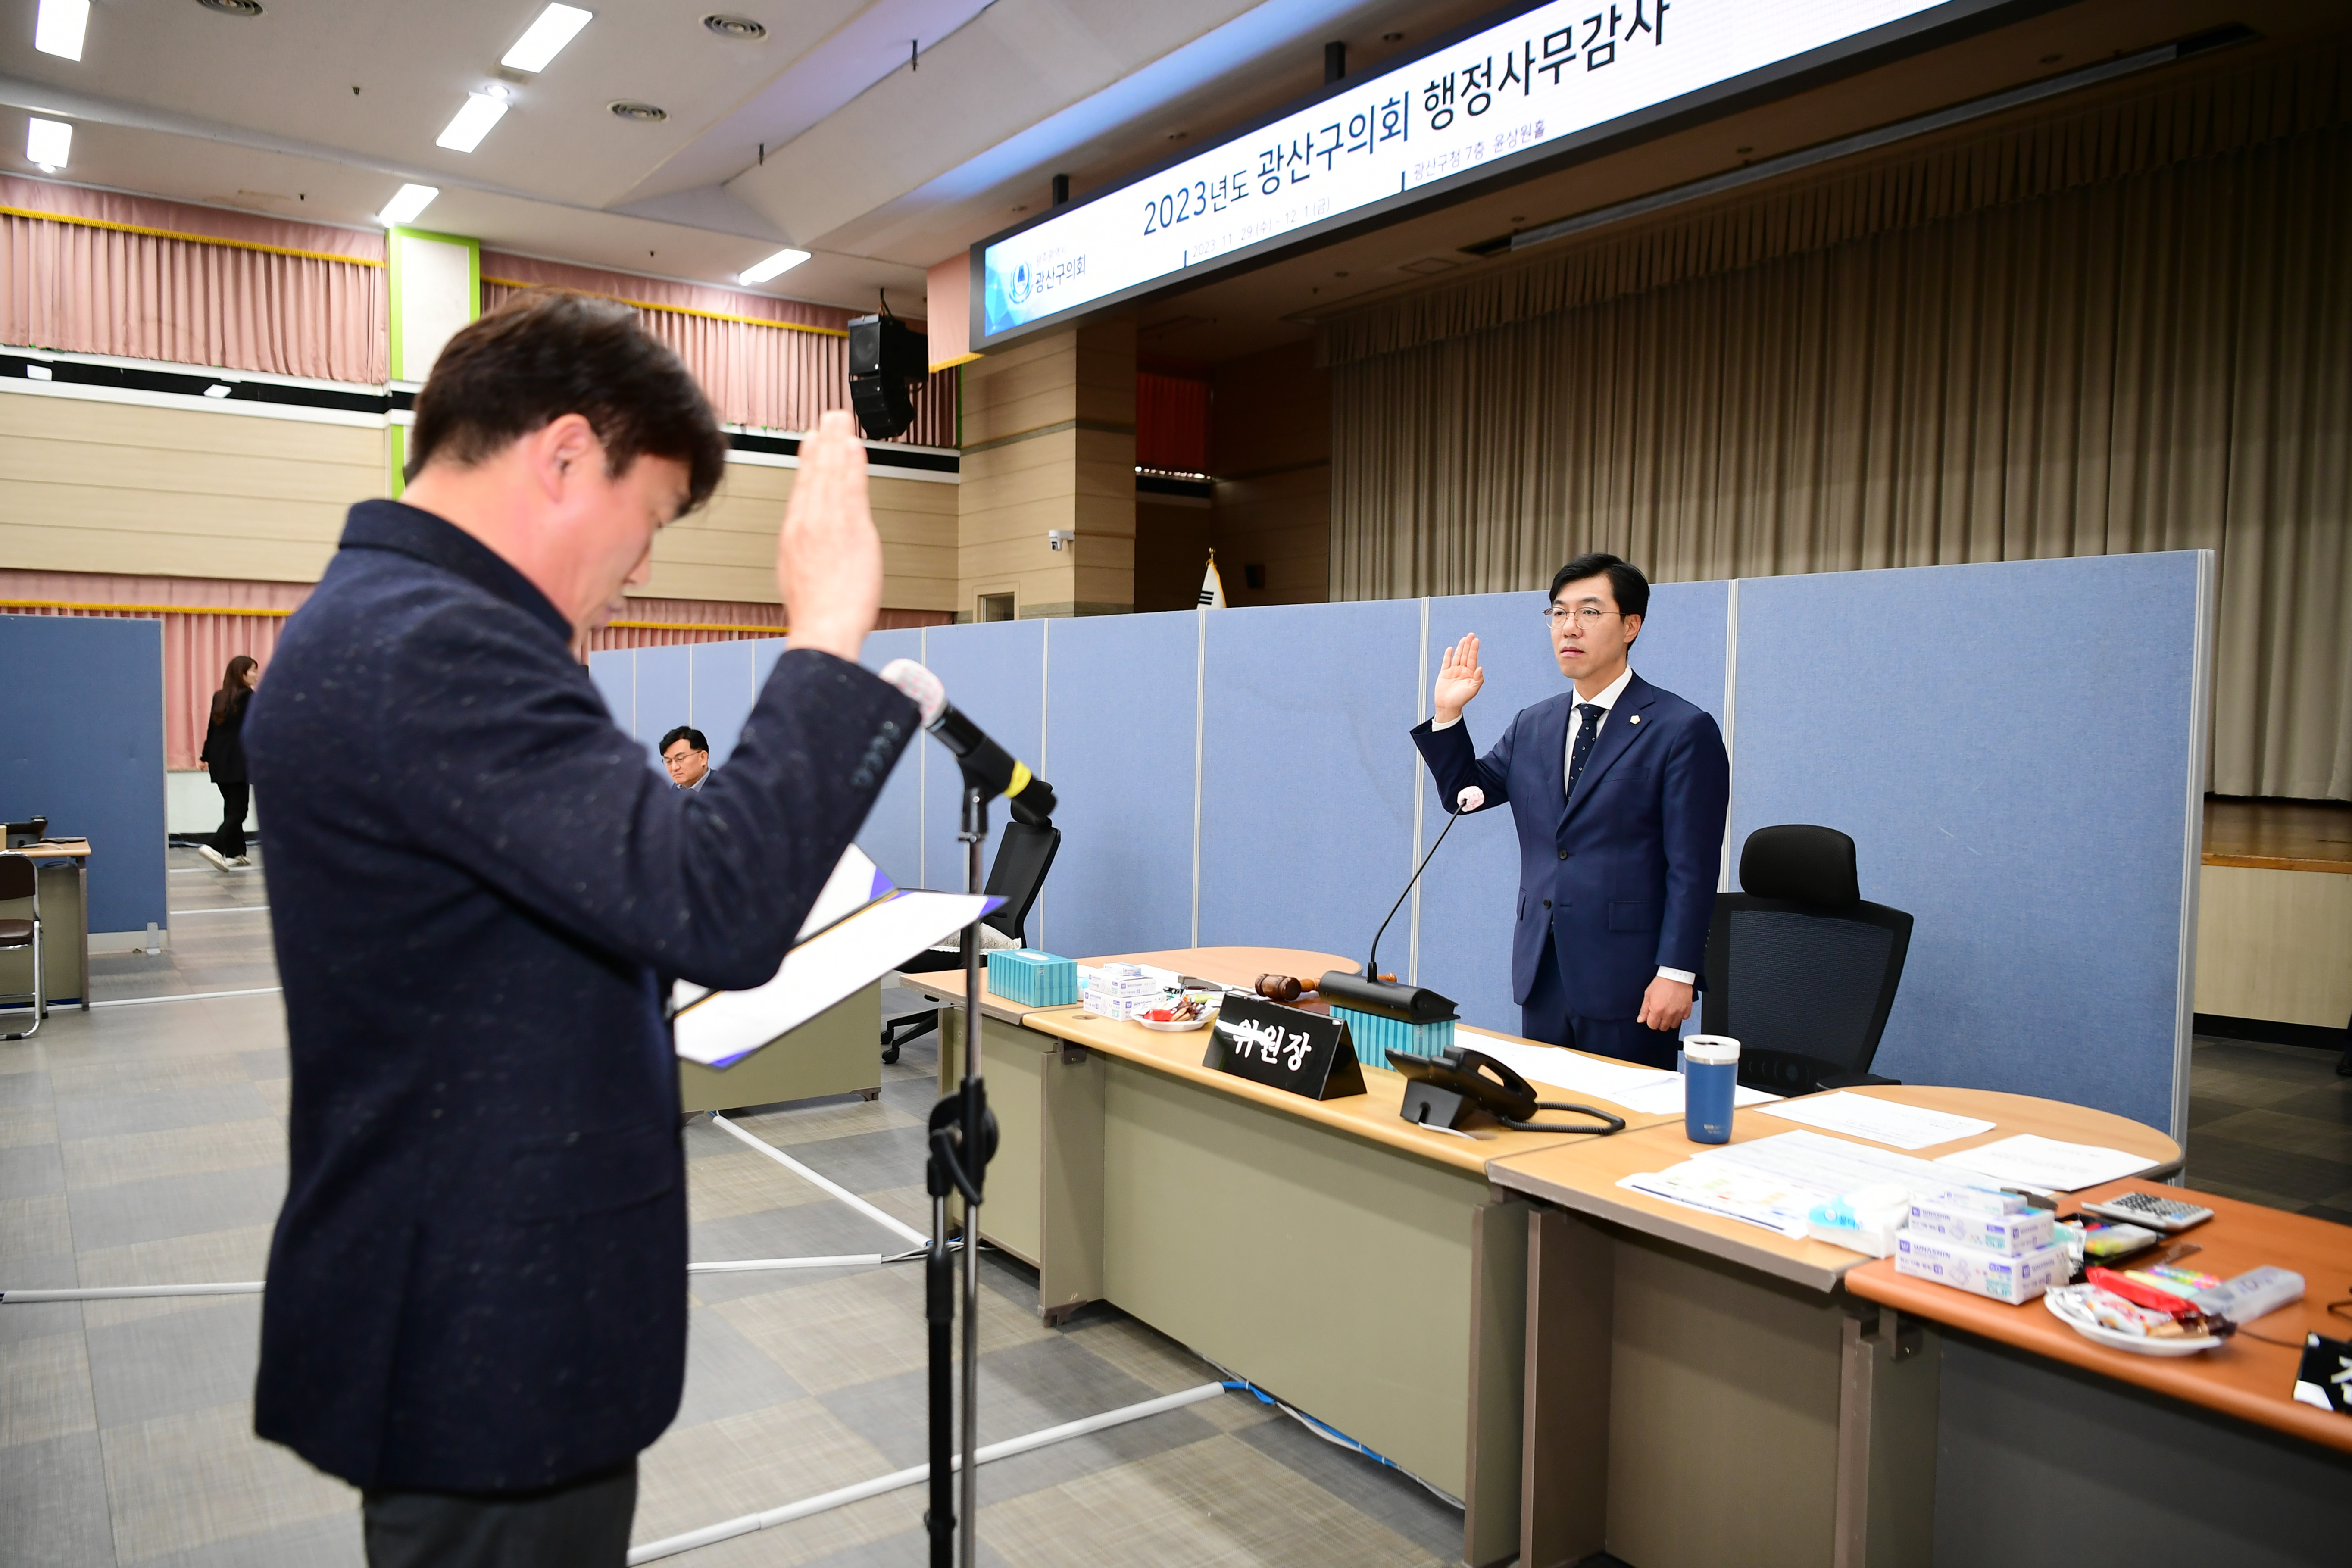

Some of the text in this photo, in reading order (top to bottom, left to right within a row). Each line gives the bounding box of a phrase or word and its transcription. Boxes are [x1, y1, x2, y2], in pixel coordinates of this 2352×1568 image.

[1143, 0, 1671, 236] 2023년도 광산구의회 행정사무감사
[1414, 119, 1546, 181] 광산구청 7층 윤상원홀
[1035, 254, 1086, 293] 광산구의회
[1233, 1019, 1312, 1071] 위원장
[1914, 1244, 1951, 1259] WHASHIN
